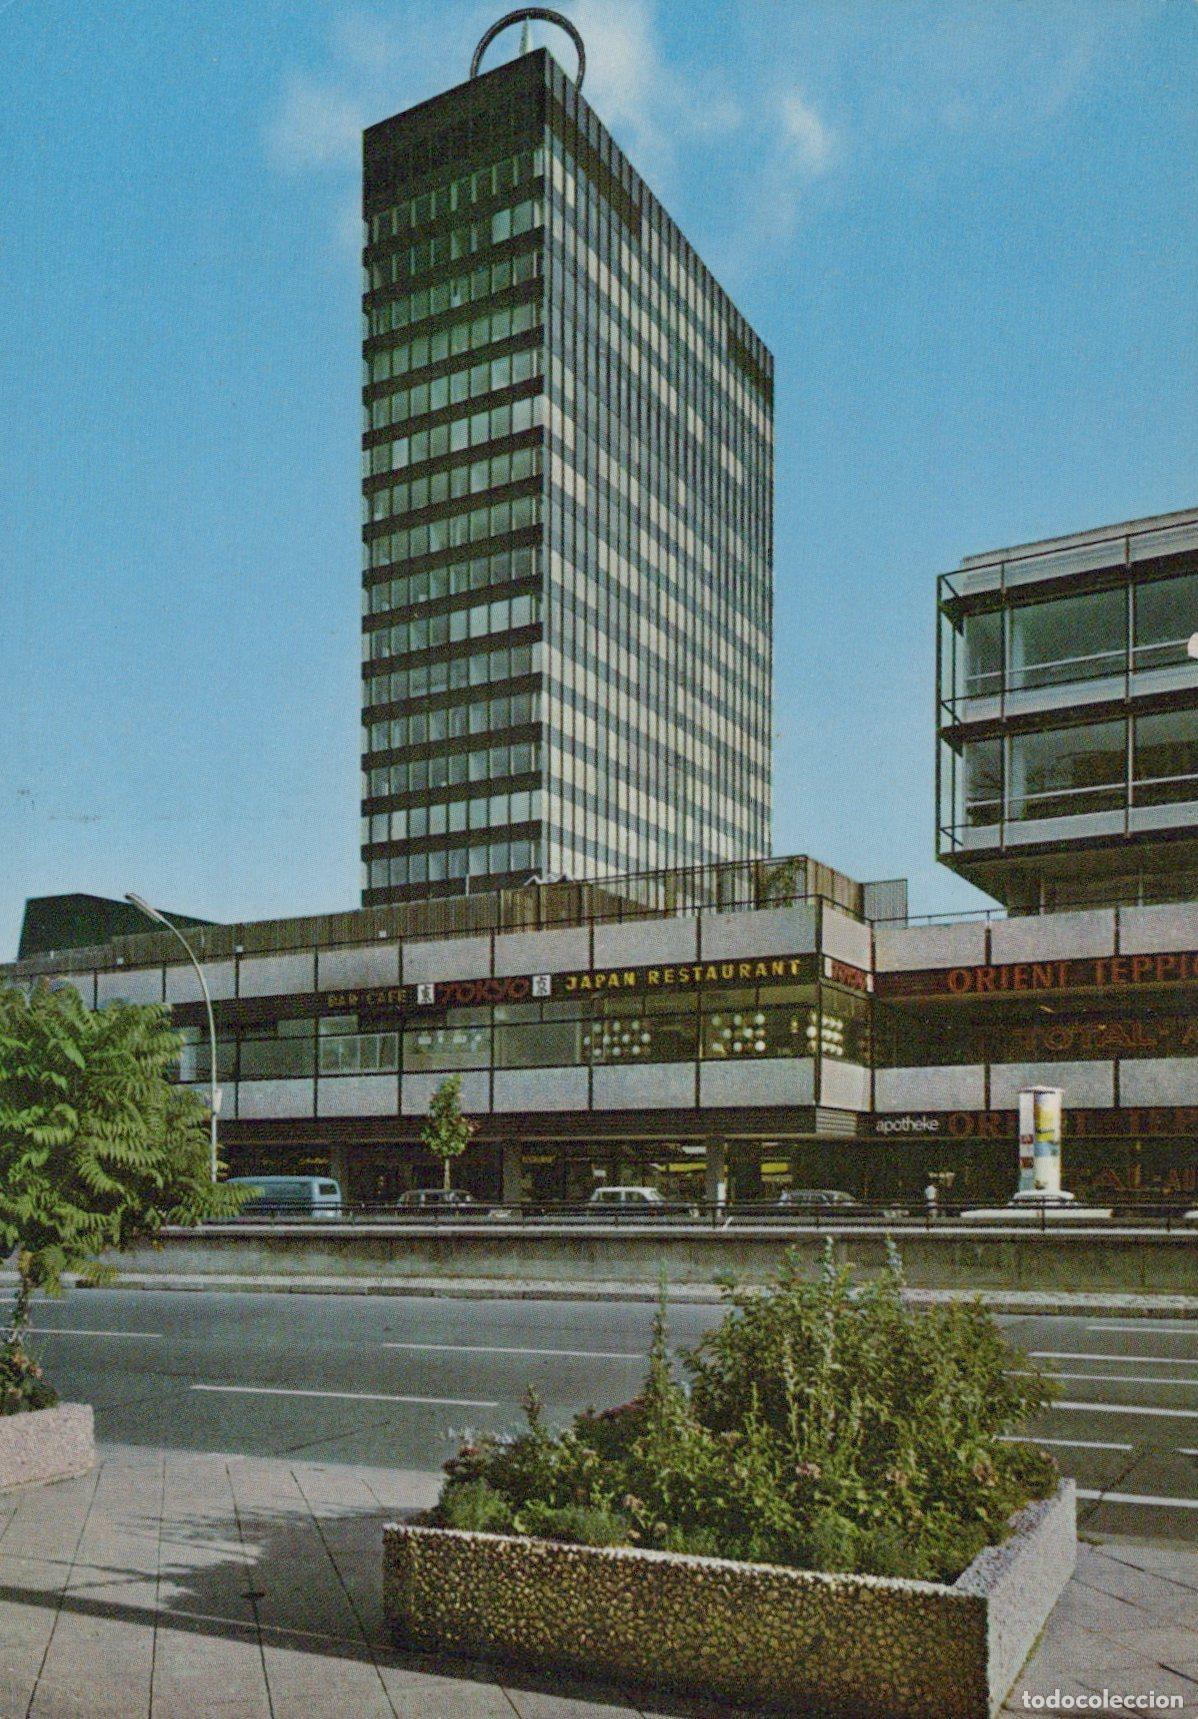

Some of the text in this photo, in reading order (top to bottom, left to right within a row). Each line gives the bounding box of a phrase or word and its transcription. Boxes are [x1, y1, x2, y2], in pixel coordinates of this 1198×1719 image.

[438, 976, 529, 1004] TOKYO
[564, 959, 801, 991] JAPAN RESTAURANT
[947, 960, 1071, 993] ORIENT
[876, 1114, 939, 1134] apotheke
